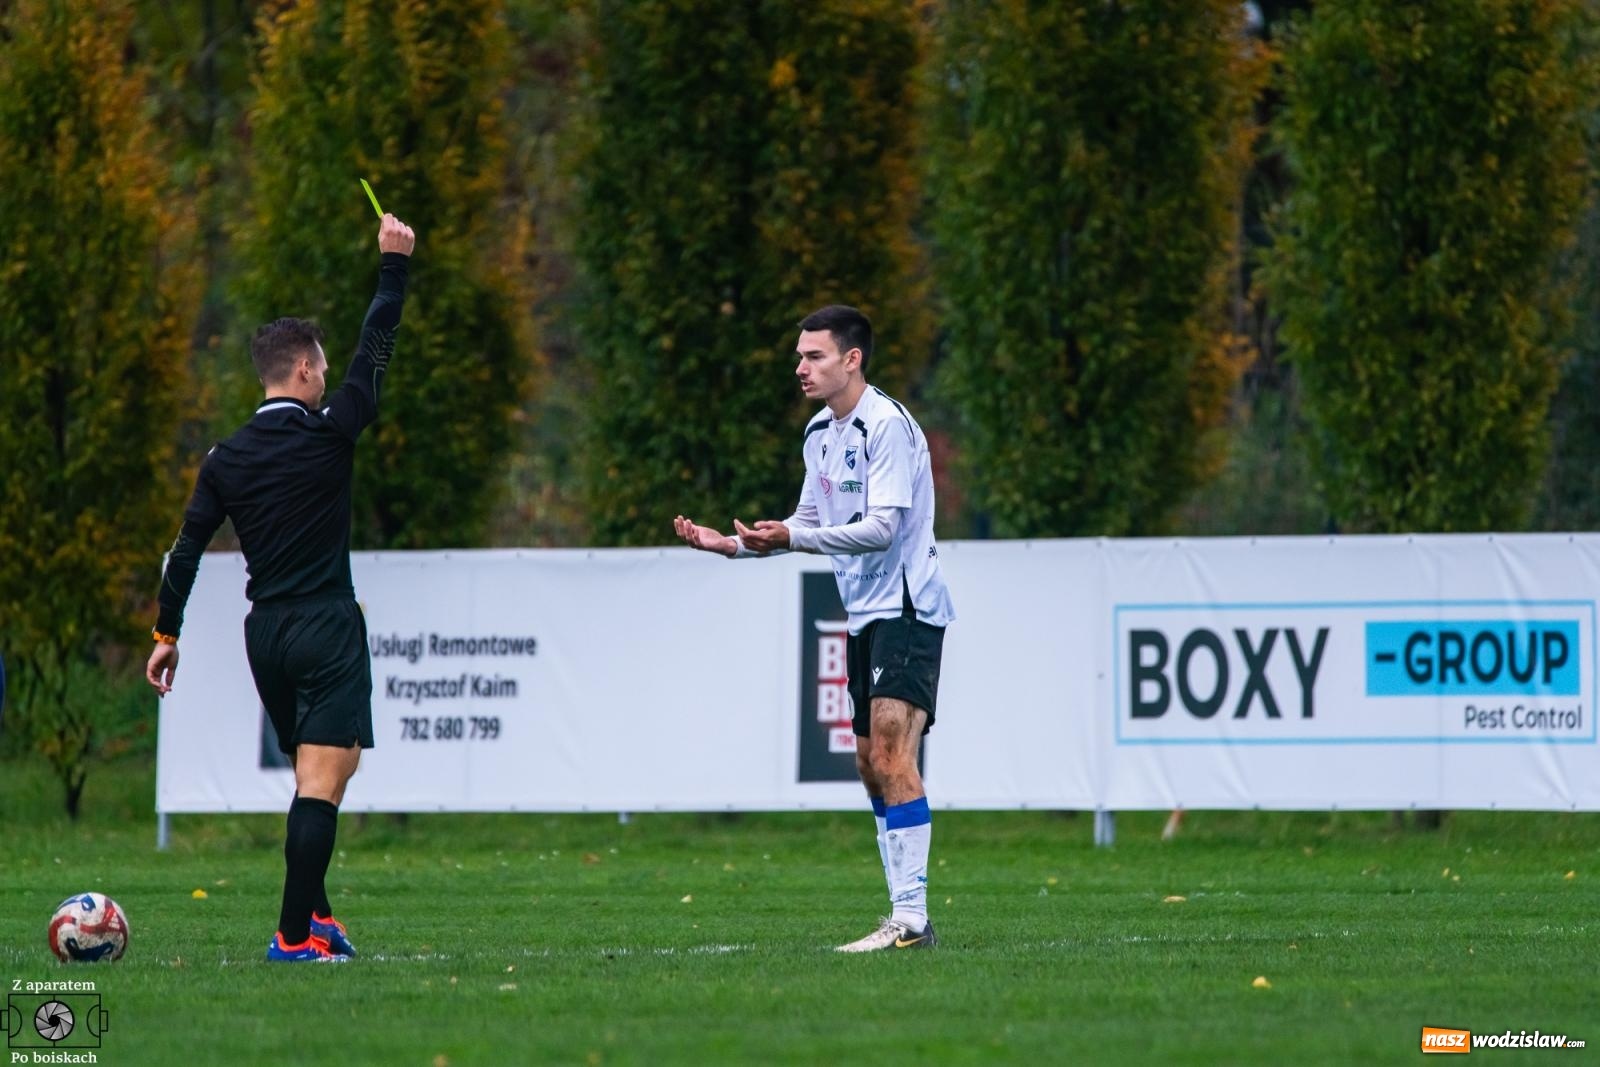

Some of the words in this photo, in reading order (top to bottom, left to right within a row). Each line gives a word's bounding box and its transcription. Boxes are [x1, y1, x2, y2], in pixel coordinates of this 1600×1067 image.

[369, 633, 423, 663] Usługi
[429, 634, 536, 656] Remontowe
[1375, 630, 1569, 684] -GROUP
[1129, 627, 1330, 719] BOXY
[386, 674, 465, 704] Krzysztof
[470, 675, 518, 698] Kaim
[401, 717, 429, 740] 782
[433, 717, 464, 740] 680
[469, 716, 500, 740] 799
[1465, 705, 1505, 729] Pest
[1512, 704, 1582, 729] Control
